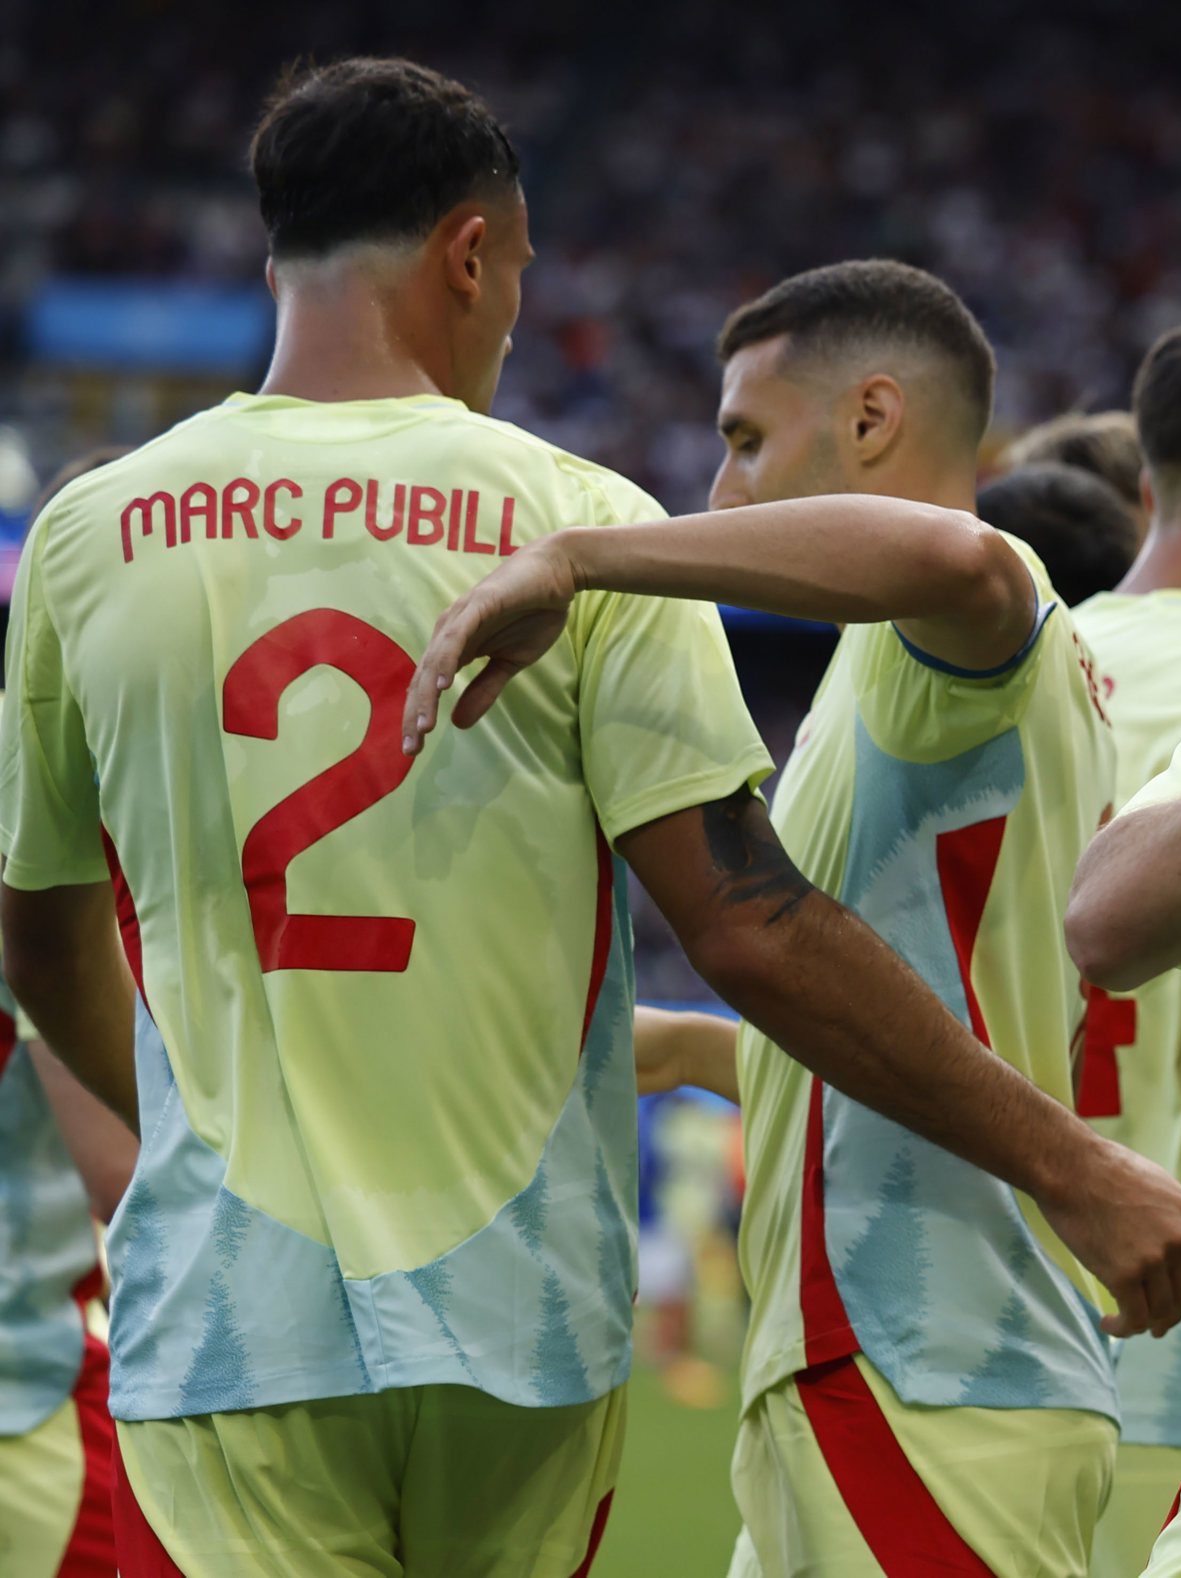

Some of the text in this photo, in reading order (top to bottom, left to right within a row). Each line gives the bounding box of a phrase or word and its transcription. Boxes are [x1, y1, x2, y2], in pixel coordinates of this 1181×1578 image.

[120, 478, 519, 563] MARC PUBILL
[223, 608, 416, 973] 2
